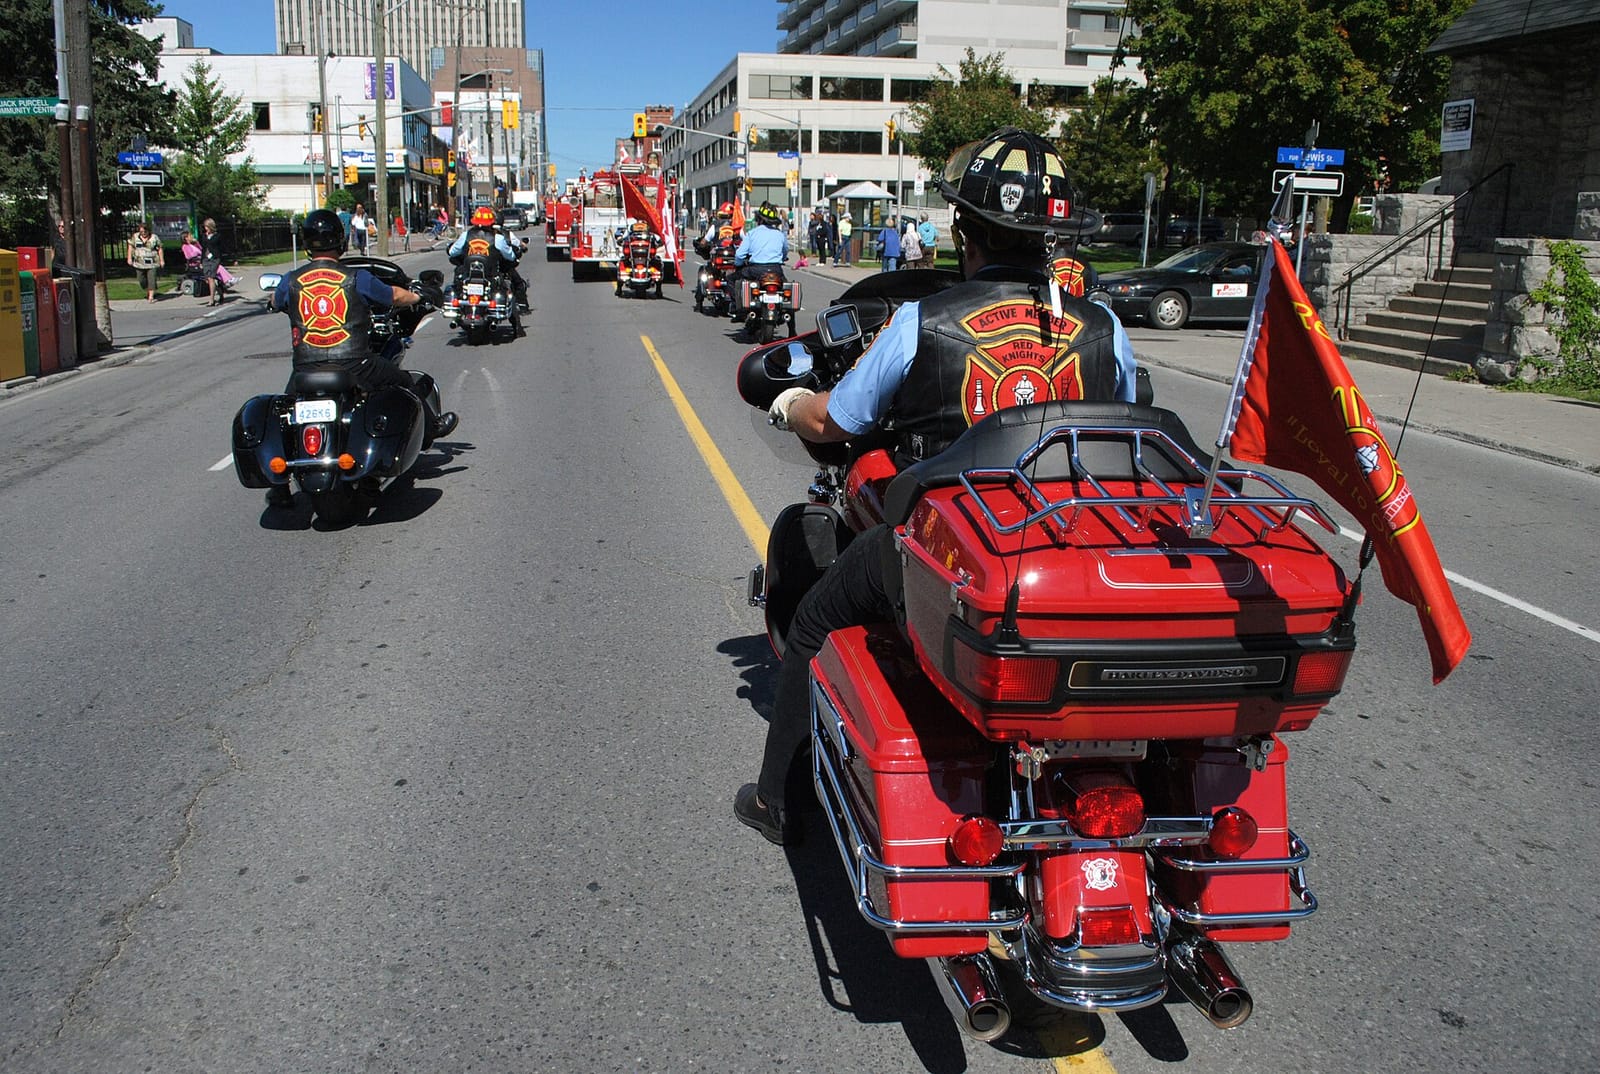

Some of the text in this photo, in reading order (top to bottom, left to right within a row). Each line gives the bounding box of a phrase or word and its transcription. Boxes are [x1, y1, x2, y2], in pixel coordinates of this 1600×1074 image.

[970, 158, 985, 173] 23
[978, 307, 1068, 331] ACTIVE MEBER
[1013, 341, 1034, 350] RED
[1001, 350, 1046, 363] KNIGHTS
[1350, 486, 1368, 511] to
[1108, 669, 1252, 680] HARLEY-DAVIDSON
